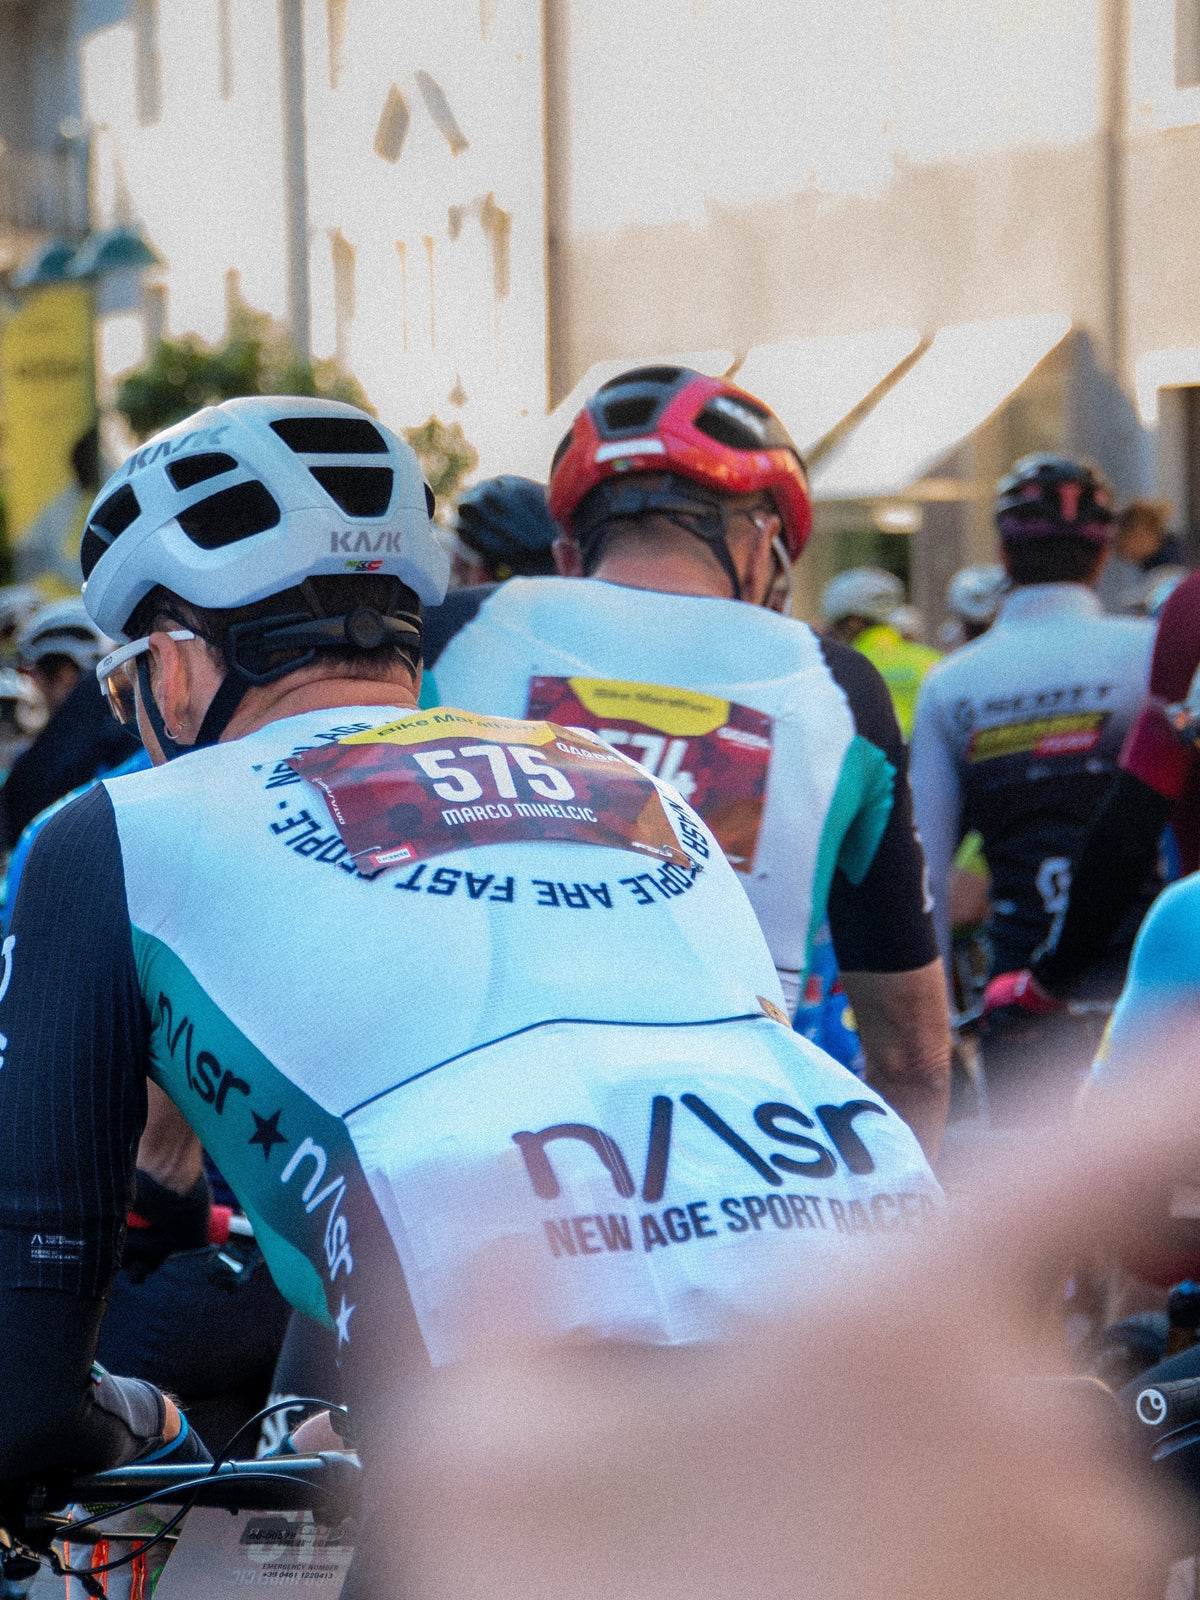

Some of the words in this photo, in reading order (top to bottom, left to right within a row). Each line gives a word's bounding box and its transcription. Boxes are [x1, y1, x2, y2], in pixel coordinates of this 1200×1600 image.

[128, 425, 229, 477] KASK
[331, 531, 402, 552] KASK
[376, 718, 430, 738] Bike
[412, 745, 577, 803] 575
[441, 803, 512, 827] MARCO
[513, 803, 599, 825] MIHELCIC
[395, 863, 515, 904] FAST
[532, 879, 614, 909] ARE
[542, 1214, 634, 1260] NEW
[641, 1200, 718, 1253] AGE
[719, 1193, 828, 1234] SPORT
